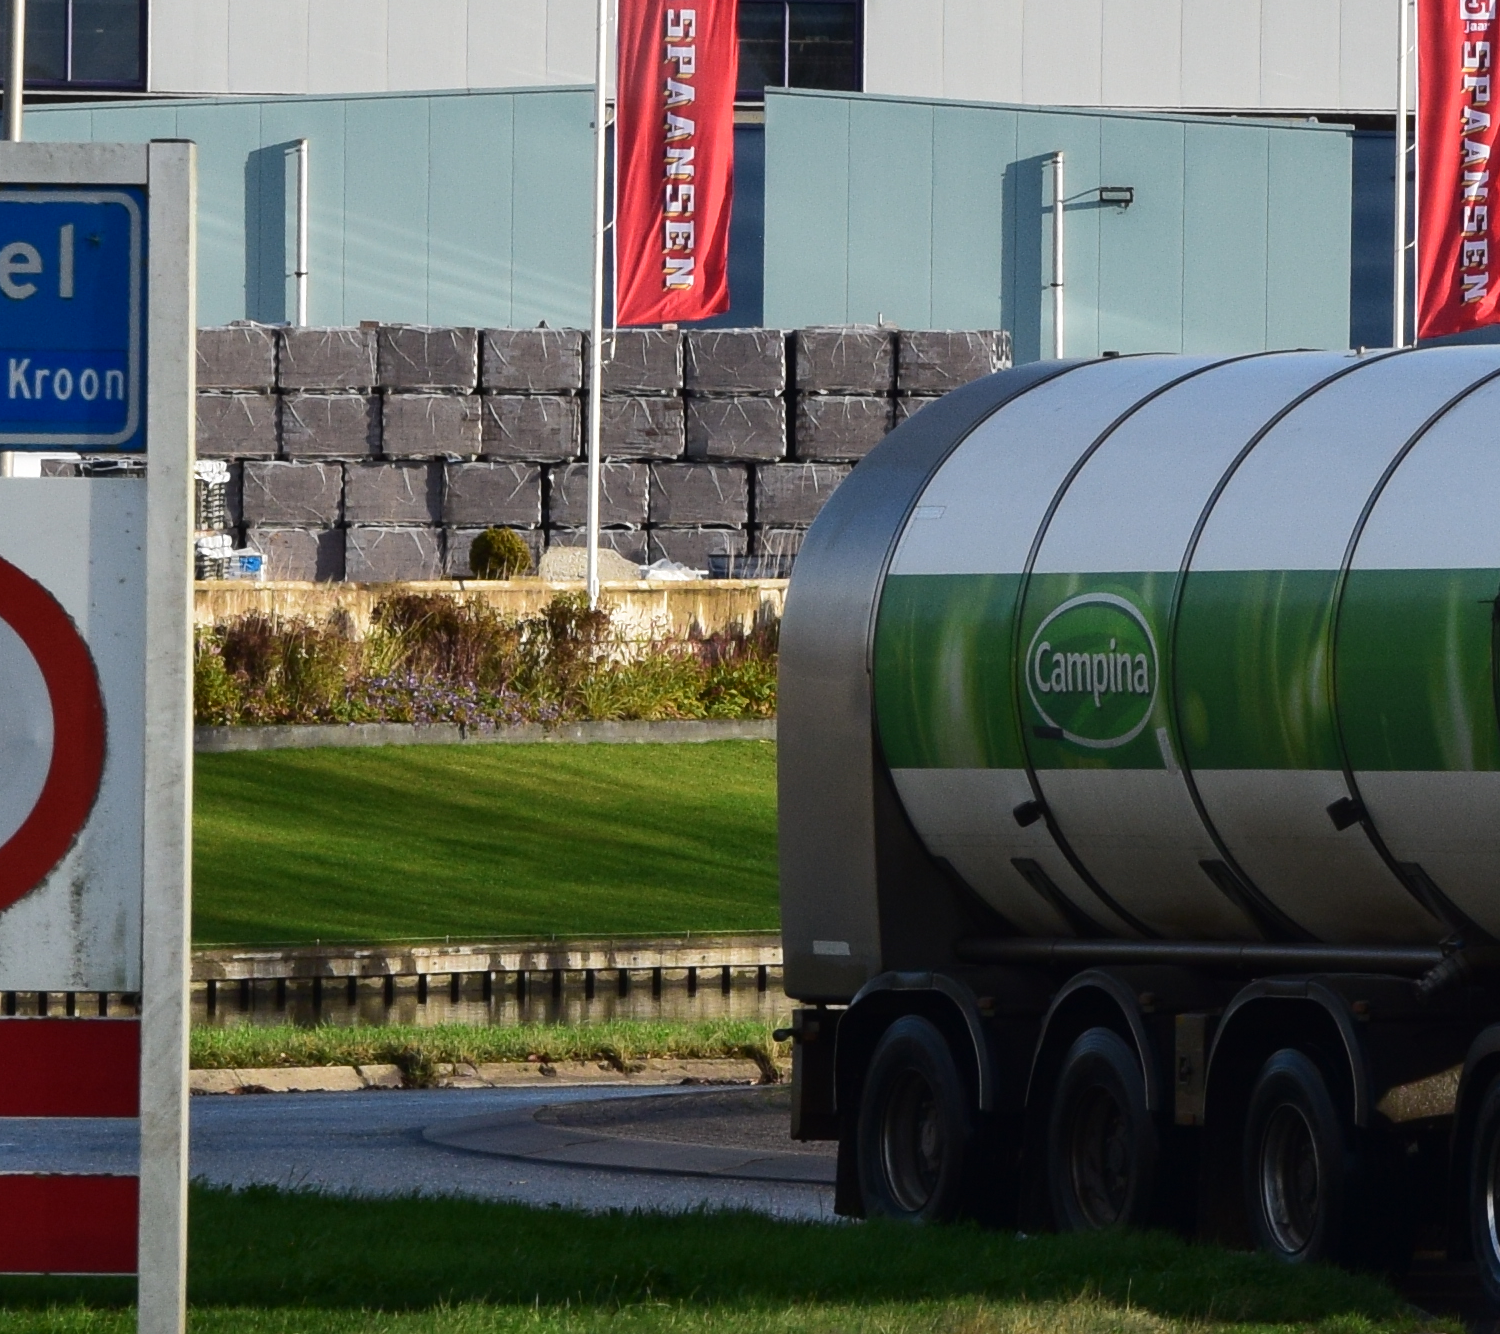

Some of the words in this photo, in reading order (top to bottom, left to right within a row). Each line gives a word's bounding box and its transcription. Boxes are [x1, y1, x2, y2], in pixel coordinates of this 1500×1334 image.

[1464, 20, 1491, 34] jaar
[663, 8, 696, 290] SPAANSEN
[1461, 40, 1491, 307] SPAANSEN
[8, 357, 125, 400] Kroon
[1034, 637, 1150, 708] Campina
